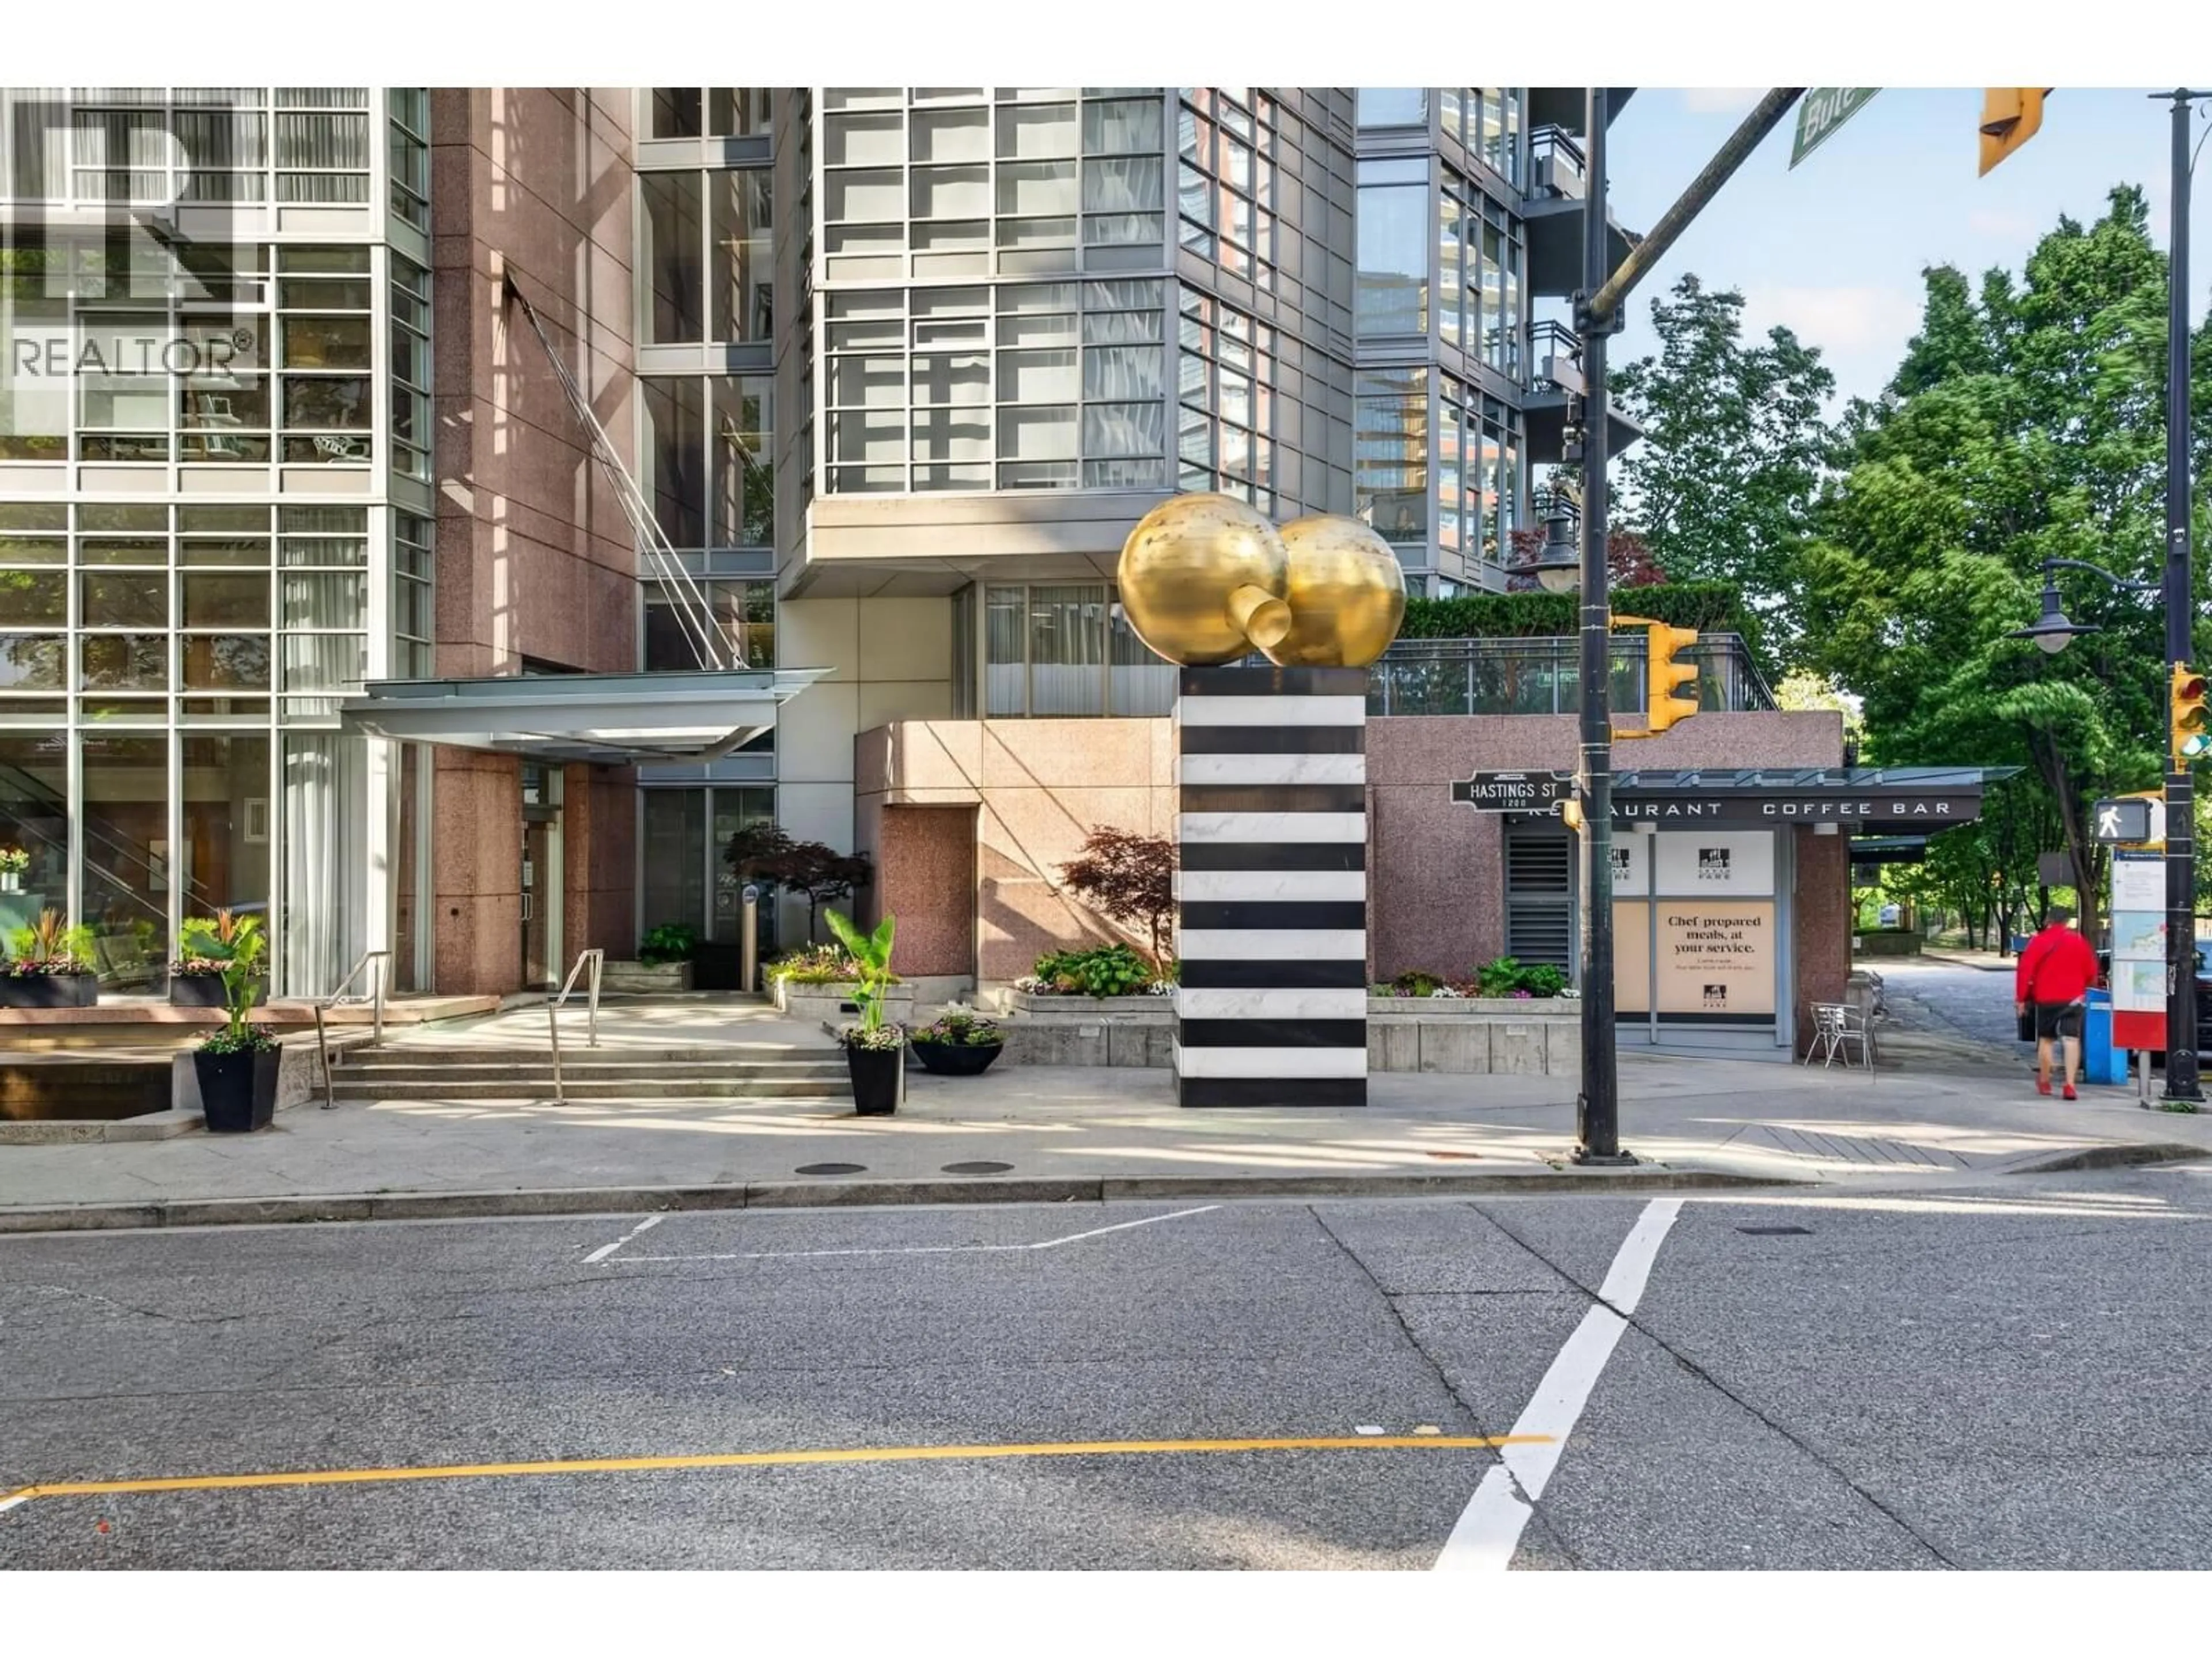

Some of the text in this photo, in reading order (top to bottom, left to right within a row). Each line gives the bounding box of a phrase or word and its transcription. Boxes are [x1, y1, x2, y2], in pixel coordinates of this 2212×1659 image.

[1470, 783, 1558, 798] HASTINGS ST
[1763, 804, 1871, 815] COFFEE
[1892, 803, 1950, 814] BAR
[1668, 916, 1761, 928] Chef prepared
[1686, 930, 1743, 940] meals, at
[1674, 943, 1755, 955] your service.
